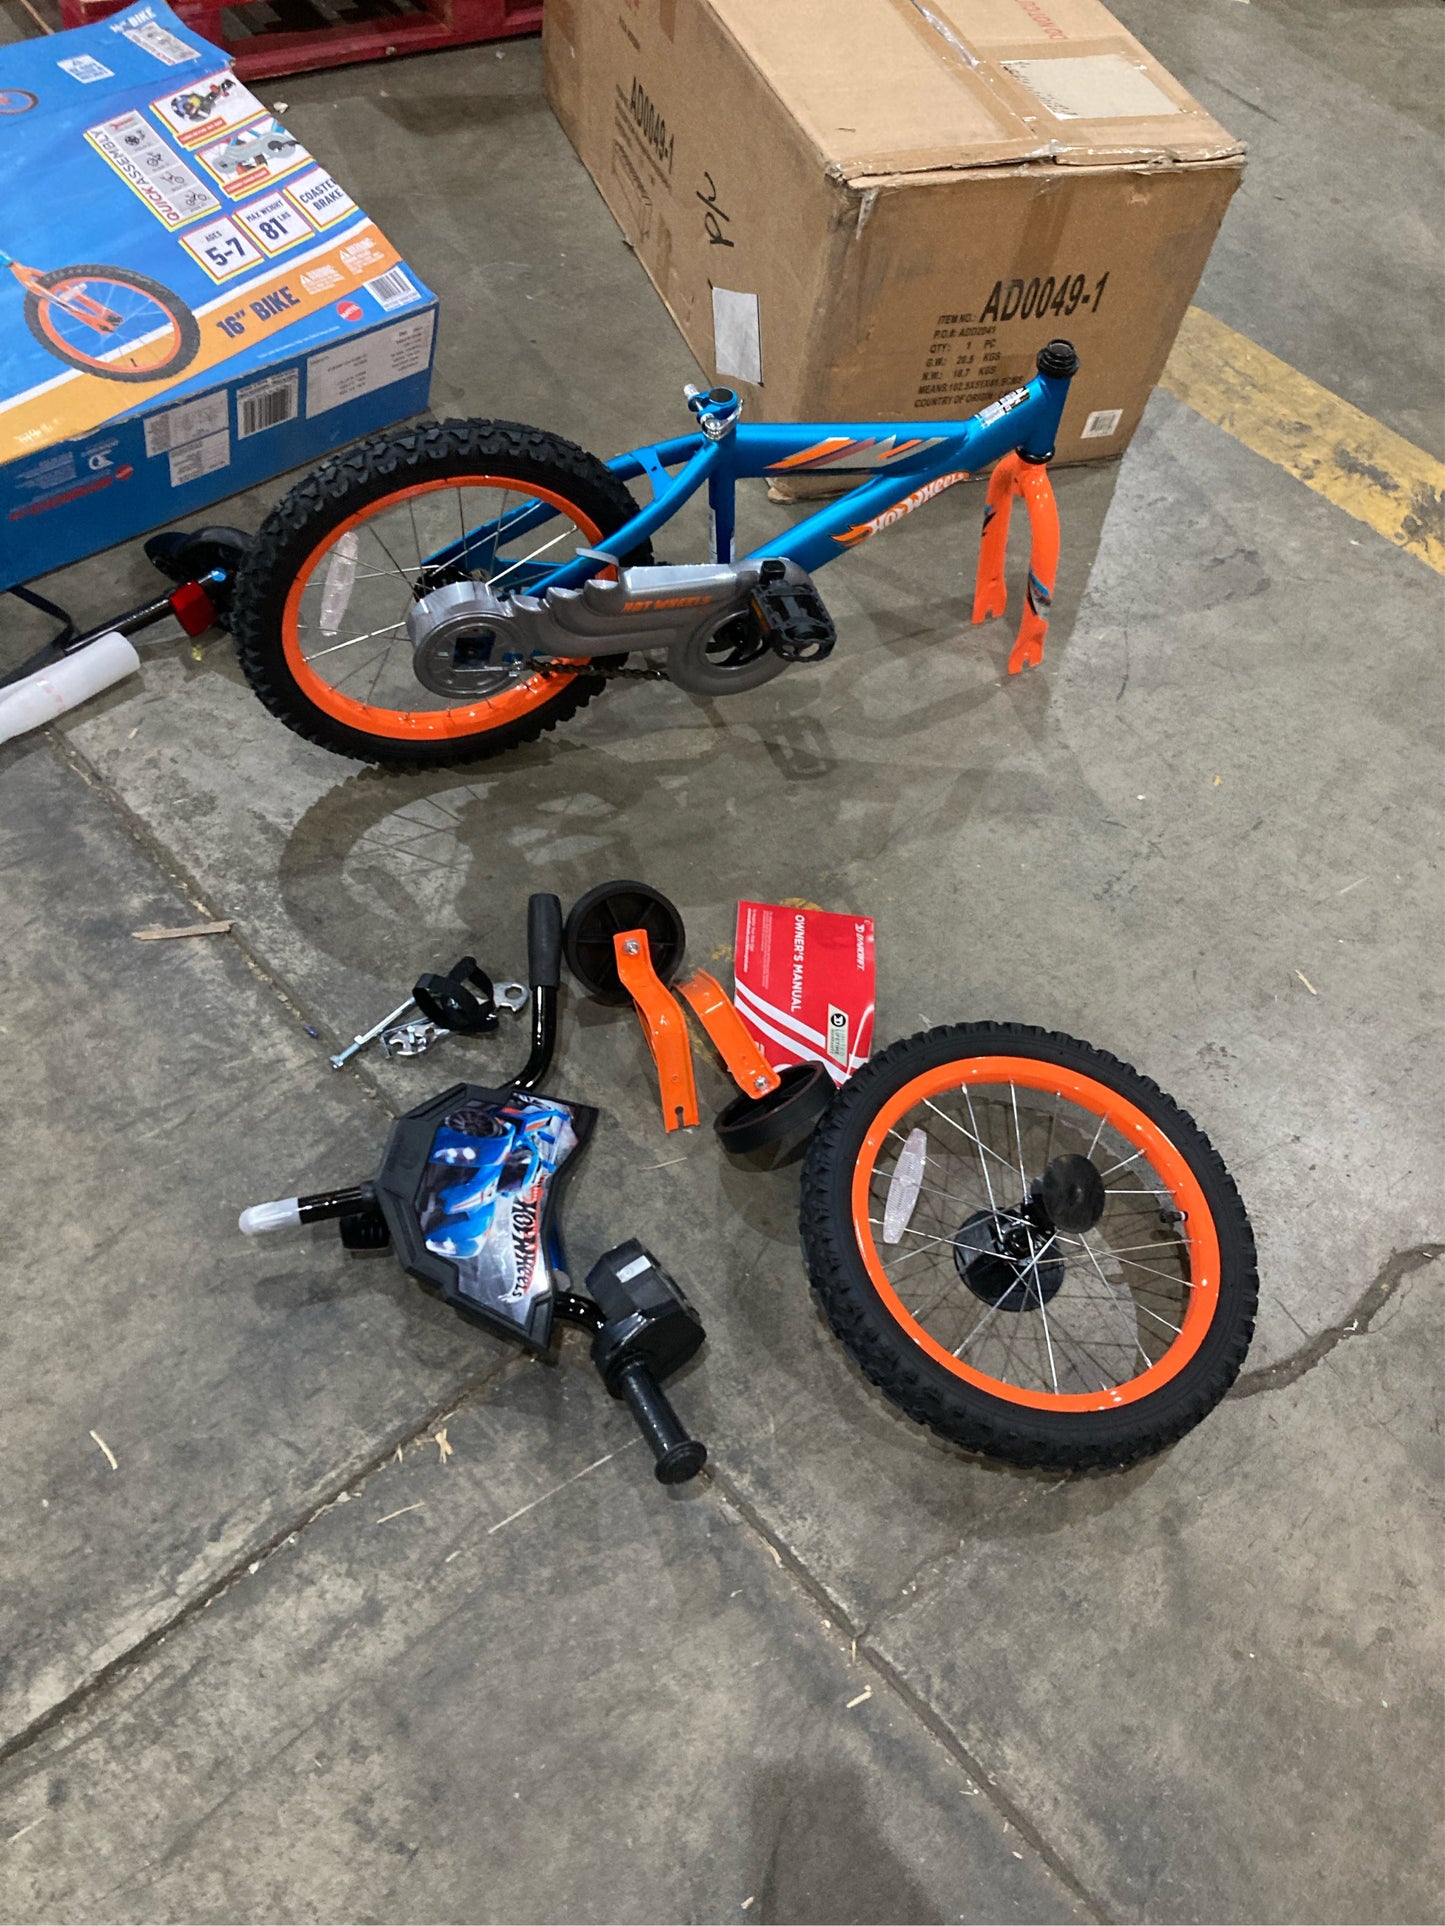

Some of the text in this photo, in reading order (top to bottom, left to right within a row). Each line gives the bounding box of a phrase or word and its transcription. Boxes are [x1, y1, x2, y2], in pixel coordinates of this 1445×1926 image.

[631, 76, 675, 174] AD0049-1
[90, 129, 148, 187] ASSEMBLY
[141, 184, 180, 222] QUICK
[245, 199, 285, 223] MAX WEIGHT
[313, 187, 344, 211] BRAKE
[204, 230, 222, 242] AGES
[259, 211, 291, 240] 81 LBS
[205, 236, 246, 267] 5-7
[216, 286, 300, 339] 16" BIKE
[937, 314, 959, 325] ITEM
[979, 271, 1110, 323] AD0049-1
[930, 339, 997, 353] QTY: 1 PC
[983, 351, 1001, 361] KGS
[978, 365, 997, 376] KGS
[914, 396, 949, 408] COUNTRY
[951, 395, 964, 405] OF
[868, 501, 908, 537] HOT
[621, 595, 713, 613] HOT WHEELS
[790, 914, 806, 1013] OWNER'S MANUAL
[511, 1200, 538, 1235] HOT
